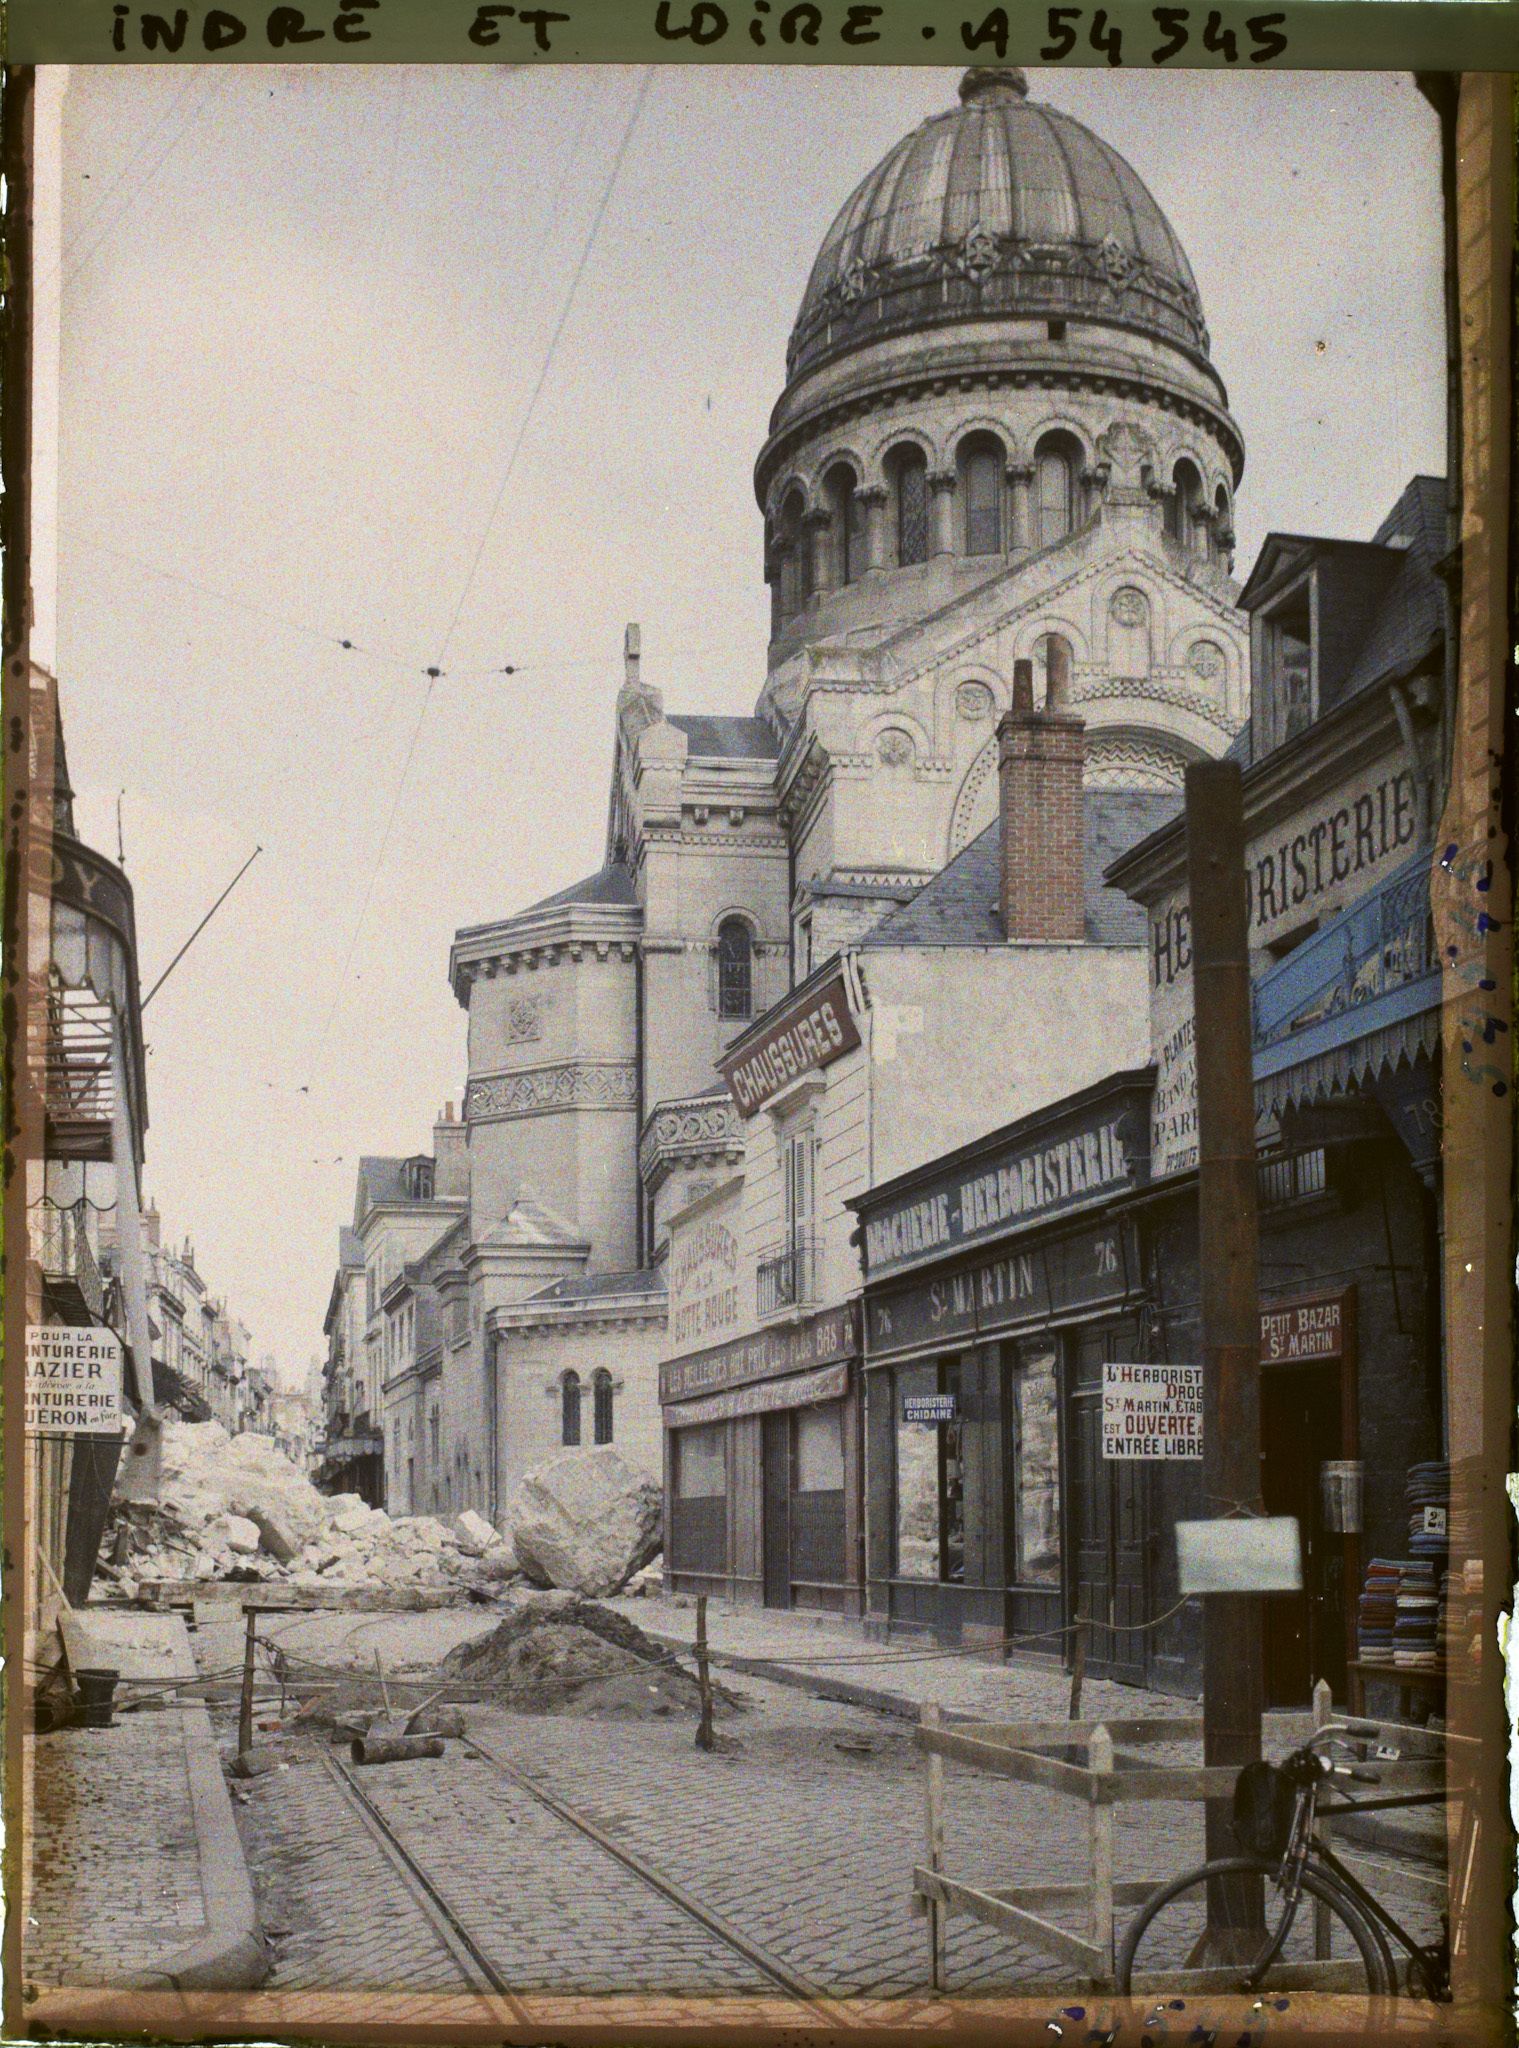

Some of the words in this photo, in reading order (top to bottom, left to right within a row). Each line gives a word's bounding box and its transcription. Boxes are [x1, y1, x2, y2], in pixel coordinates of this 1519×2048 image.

[467, 4, 571, 52] ET
[733, 1002, 843, 1106] CHAUSSURES
[1094, 1238, 1117, 1276] 76
[952, 1253, 1033, 1315] MARTIN
[31, 1332, 71, 1342] POUR
[77, 1333, 93, 1342] LA
[1261, 1313, 1291, 1340] PETIT
[1297, 1304, 1340, 1333] BAZAR
[816, 1322, 838, 1358] BAS
[1287, 1331, 1333, 1356] MARTIN
[904, 1396, 954, 1409] HERBORISTERIE
[907, 1409, 953, 1420] CHIDAINE
[1104, 1423, 1121, 1434] EST
[1125, 1415, 1196, 1436] OUVERTE
[1106, 1435, 1160, 1455] ENTRÉE
